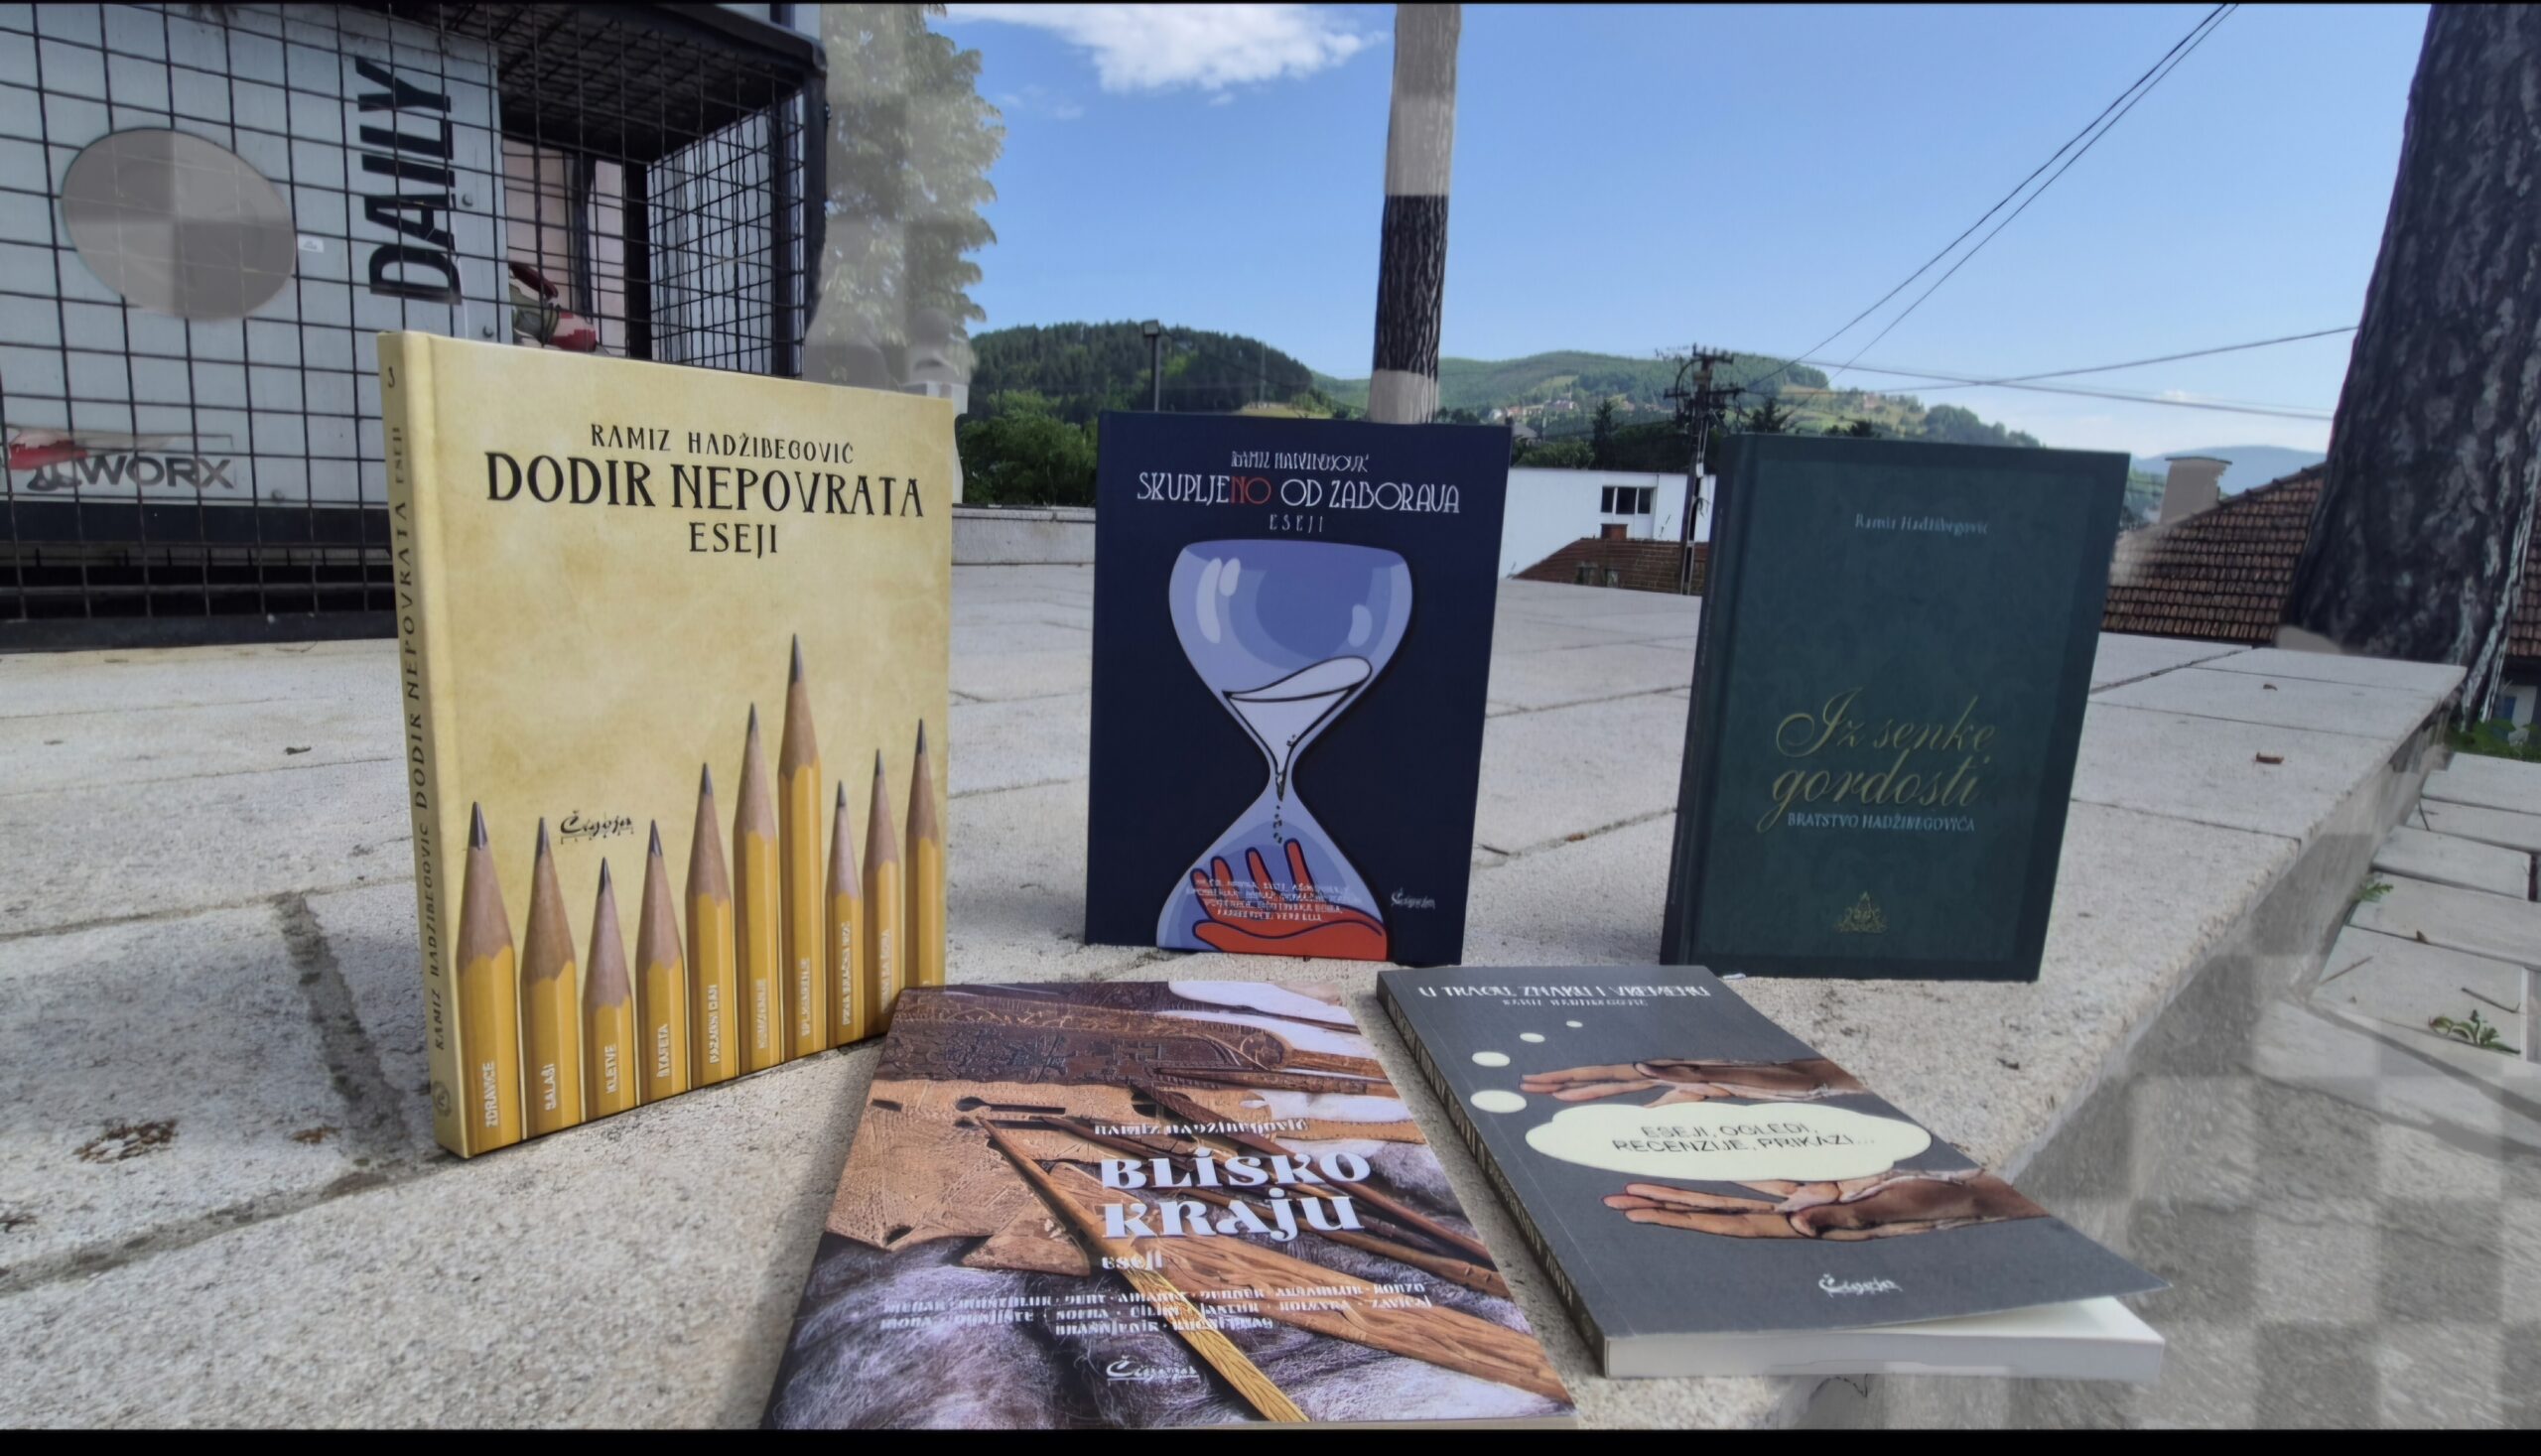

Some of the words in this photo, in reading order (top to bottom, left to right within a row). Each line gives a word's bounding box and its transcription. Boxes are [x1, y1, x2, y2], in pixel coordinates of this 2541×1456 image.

[355, 56, 463, 306] DAILY
[591, 423, 671, 452] RAMIZ
[688, 431, 855, 464] HADŽIBEGOVIĆ
[483, 451, 657, 509] DODIR
[670, 463, 925, 518] NEPOVRATA
[1137, 471, 1271, 507] SKUPLJENO
[1280, 478, 1323, 507] OD
[1328, 479, 1460, 513] ZABORAVA
[688, 521, 779, 559] ESEJI
[1270, 514, 1324, 533] ESEJI
[1872, 695, 1997, 752] senke
[410, 713, 429, 811] DODIR
[1756, 744, 1991, 834] gordosti
[1787, 812, 1859, 828] BRATSTVO
